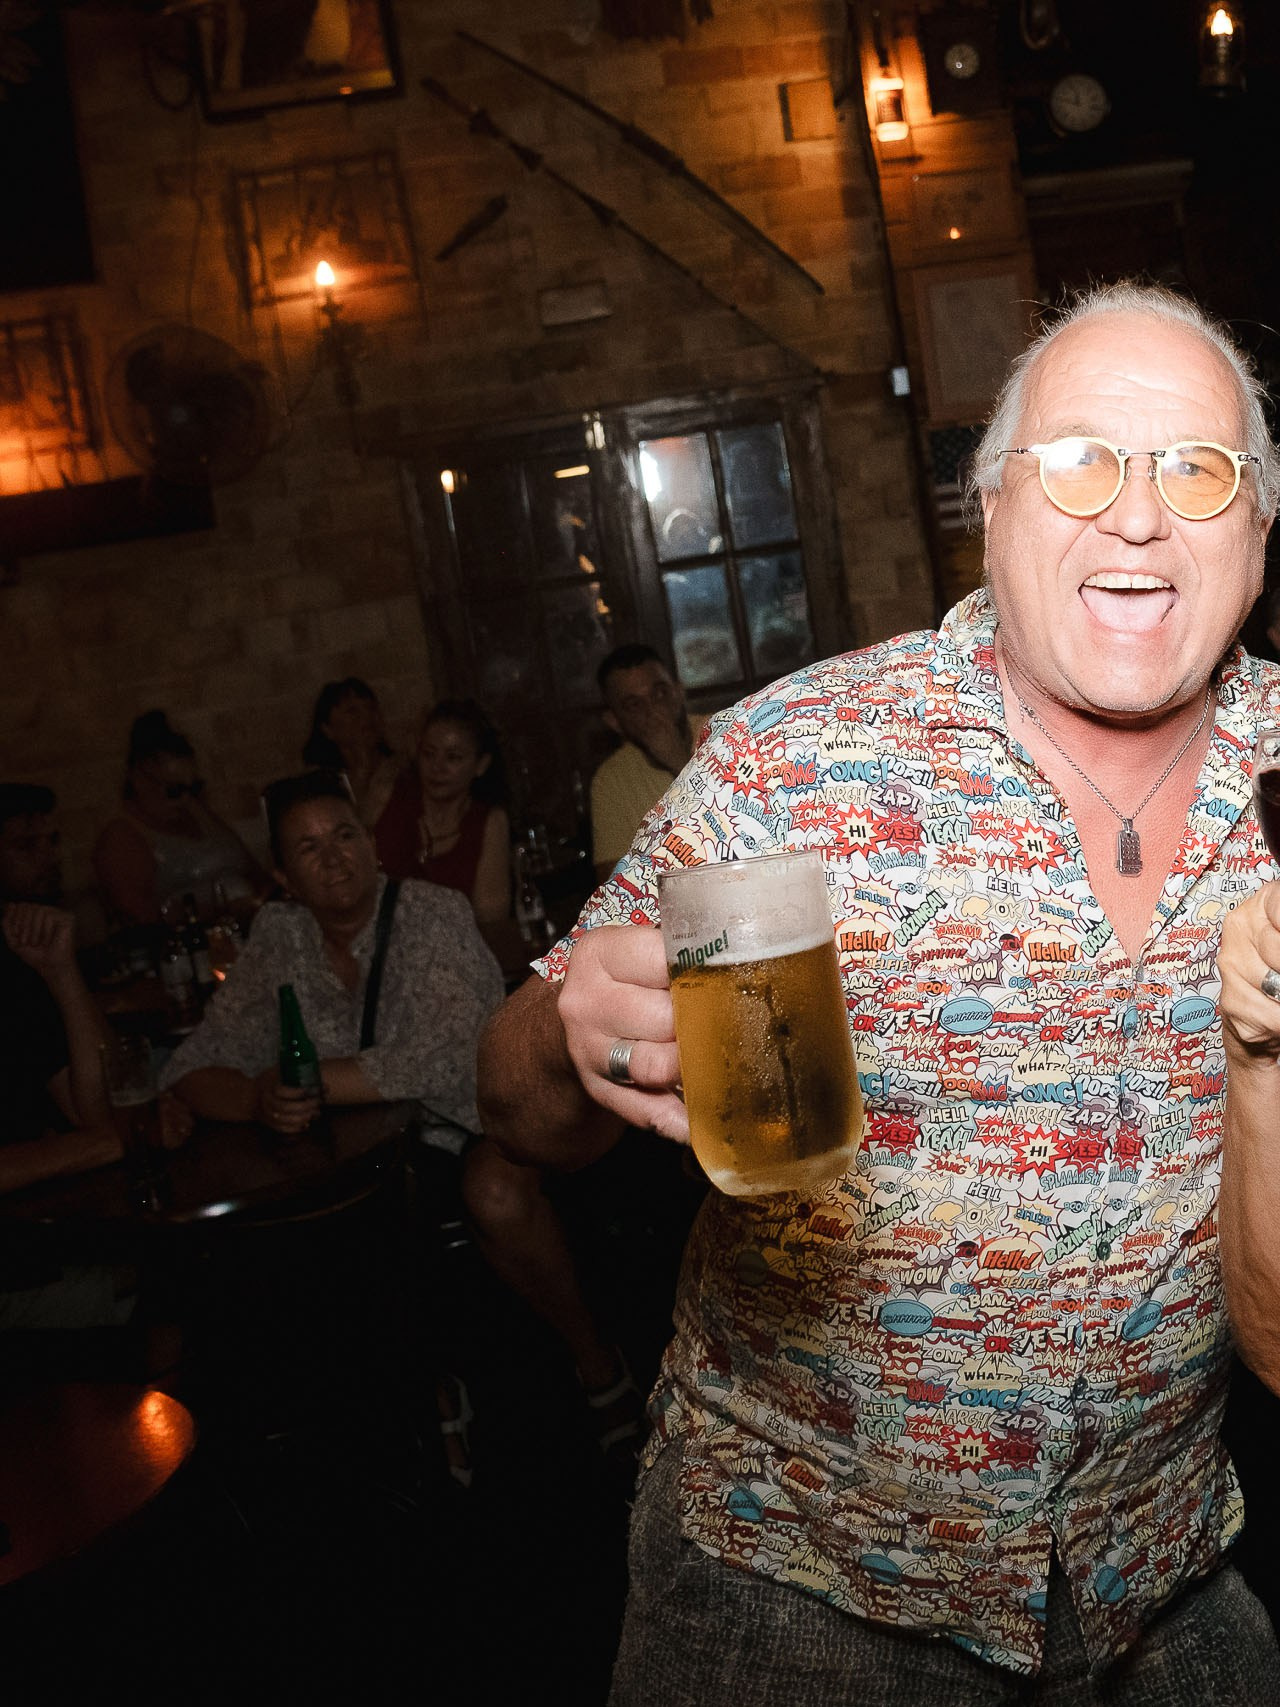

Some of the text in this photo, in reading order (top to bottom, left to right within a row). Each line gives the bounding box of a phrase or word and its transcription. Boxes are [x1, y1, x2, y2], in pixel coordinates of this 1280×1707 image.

[836, 707, 863, 722] OK
[824, 741, 872, 752] WHAT?!
[957, 735, 993, 750] ZONK
[739, 761, 754, 778] HI
[830, 760, 889, 788] OMG!
[960, 776, 994, 796] OMG
[871, 787, 920, 814] ZAP!
[794, 805, 828, 821] ZONK
[926, 802, 963, 819] HELL
[848, 825, 866, 839] HI
[922, 819, 970, 845] YEAH
[975, 816, 1008, 831] ZONK
[1028, 838, 1044, 854] HI
[987, 876, 1022, 896] HELL
[994, 904, 1022, 920] OK
[841, 931, 888, 950] Hello!
[1029, 942, 1077, 962] Hello!
[959, 961, 999, 983] WOW
[1177, 961, 1212, 984] WOW
[853, 1015, 881, 1032] OK
[1040, 1025, 1070, 1042] OK
[980, 1042, 1020, 1058] ZONK
[1017, 1061, 1066, 1076] WHAT?!
[1022, 1080, 1085, 1109] OMG!
[930, 1105, 969, 1123] HELL
[1062, 1107, 1115, 1131] ZAP!
[1150, 1108, 1187, 1133] HELL
[920, 1125, 970, 1151] YEAH
[978, 1124, 1013, 1139] ZONK
[1144, 1127, 1188, 1158] YEAH
[1029, 1145, 1049, 1158] HI
[967, 1182, 1003, 1202] HELL
[965, 1208, 995, 1225] OK
[983, 1249, 1037, 1270] Hello!
[900, 1265, 944, 1285] WOW
[983, 1335, 1016, 1352] OK
[963, 1370, 1019, 1382] WHAT?!
[959, 1387, 1032, 1412] OMG!
[861, 1401, 901, 1417] HELL
[857, 1415, 903, 1443] YEAH
[908, 1420, 943, 1437] ZONK
[961, 1444, 980, 1458] HI
[932, 1519, 984, 1542] Hello!
